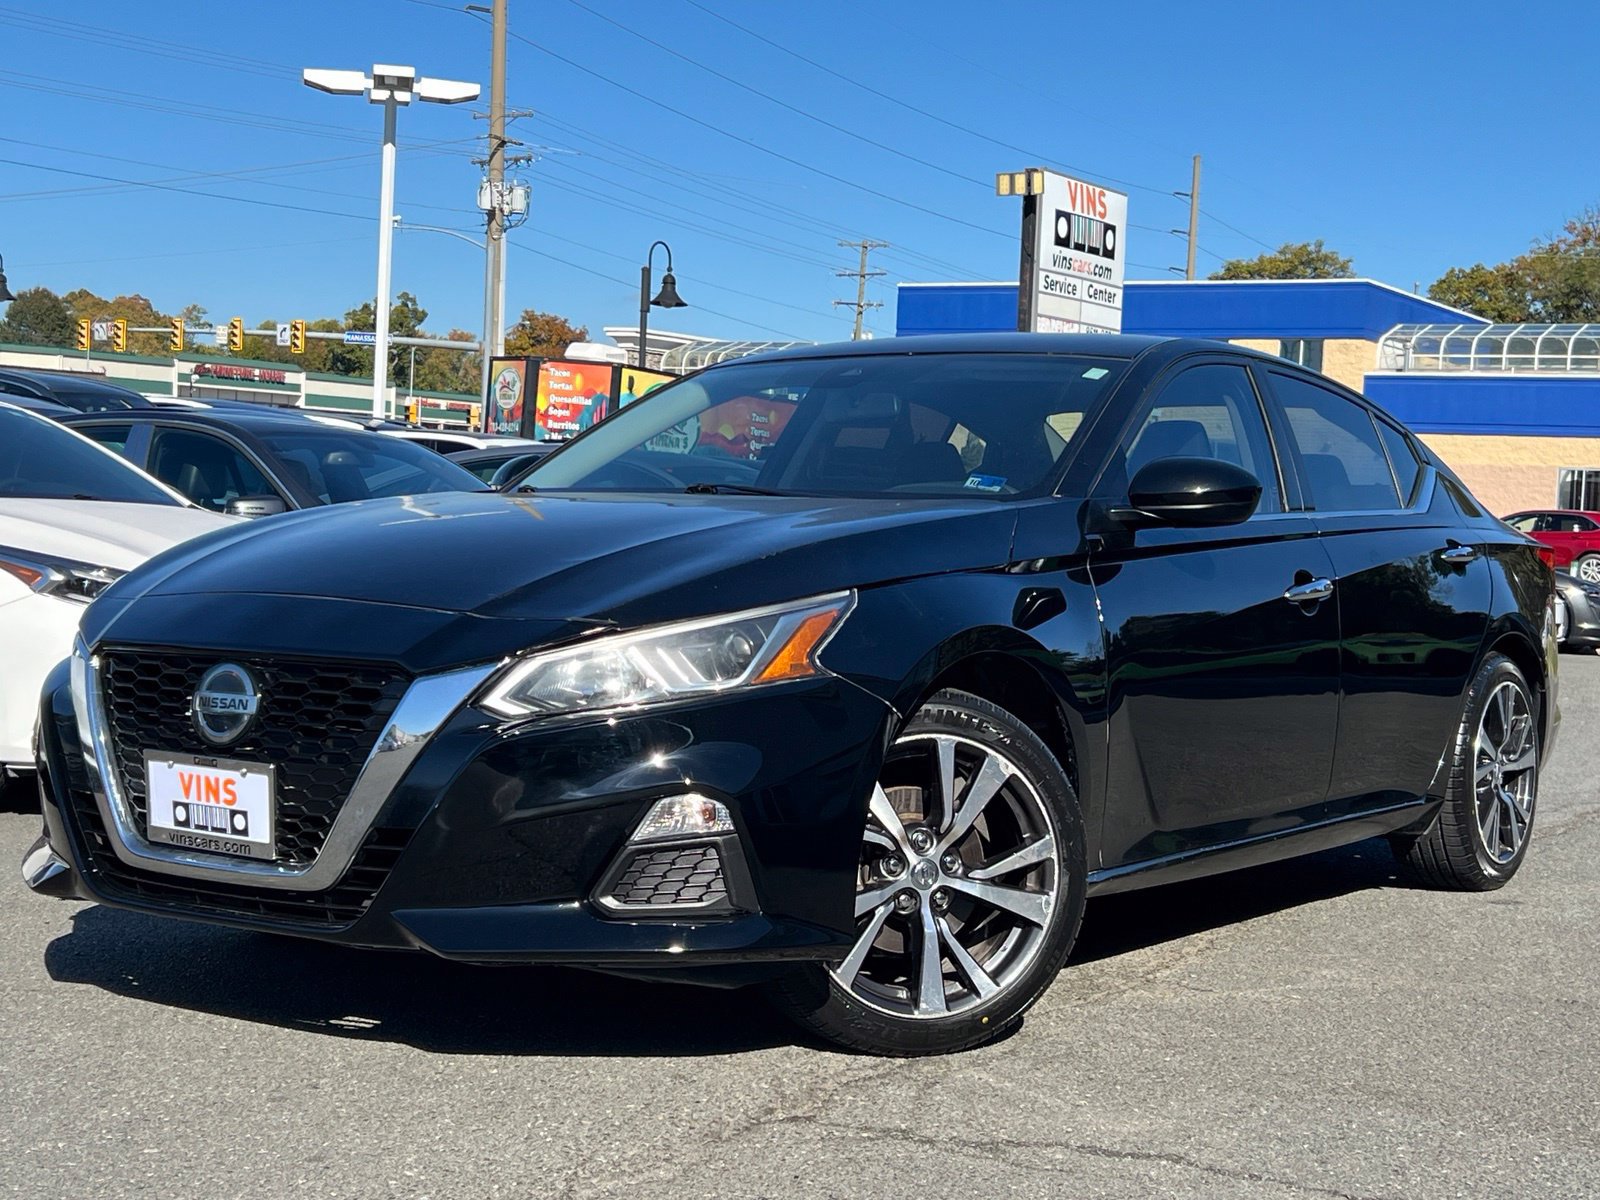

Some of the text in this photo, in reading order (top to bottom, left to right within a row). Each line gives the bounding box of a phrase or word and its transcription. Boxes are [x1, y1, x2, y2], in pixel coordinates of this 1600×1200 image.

[1067, 180, 1107, 220] VINS
[1052, 250, 1113, 281] vinscars.com
[1043, 274, 1117, 305] Service Center
[345, 334, 377, 342] MANASSA
[549, 367, 571, 377] Tacos
[548, 381, 573, 391] Tortas
[549, 394, 592, 406] Quesadillas
[548, 406, 571, 418] Sopes
[547, 420, 580, 431] Burritos
[200, 696, 249, 711] NISSAN
[178, 771, 238, 807] VINS
[168, 831, 251, 855] vinscars.com
